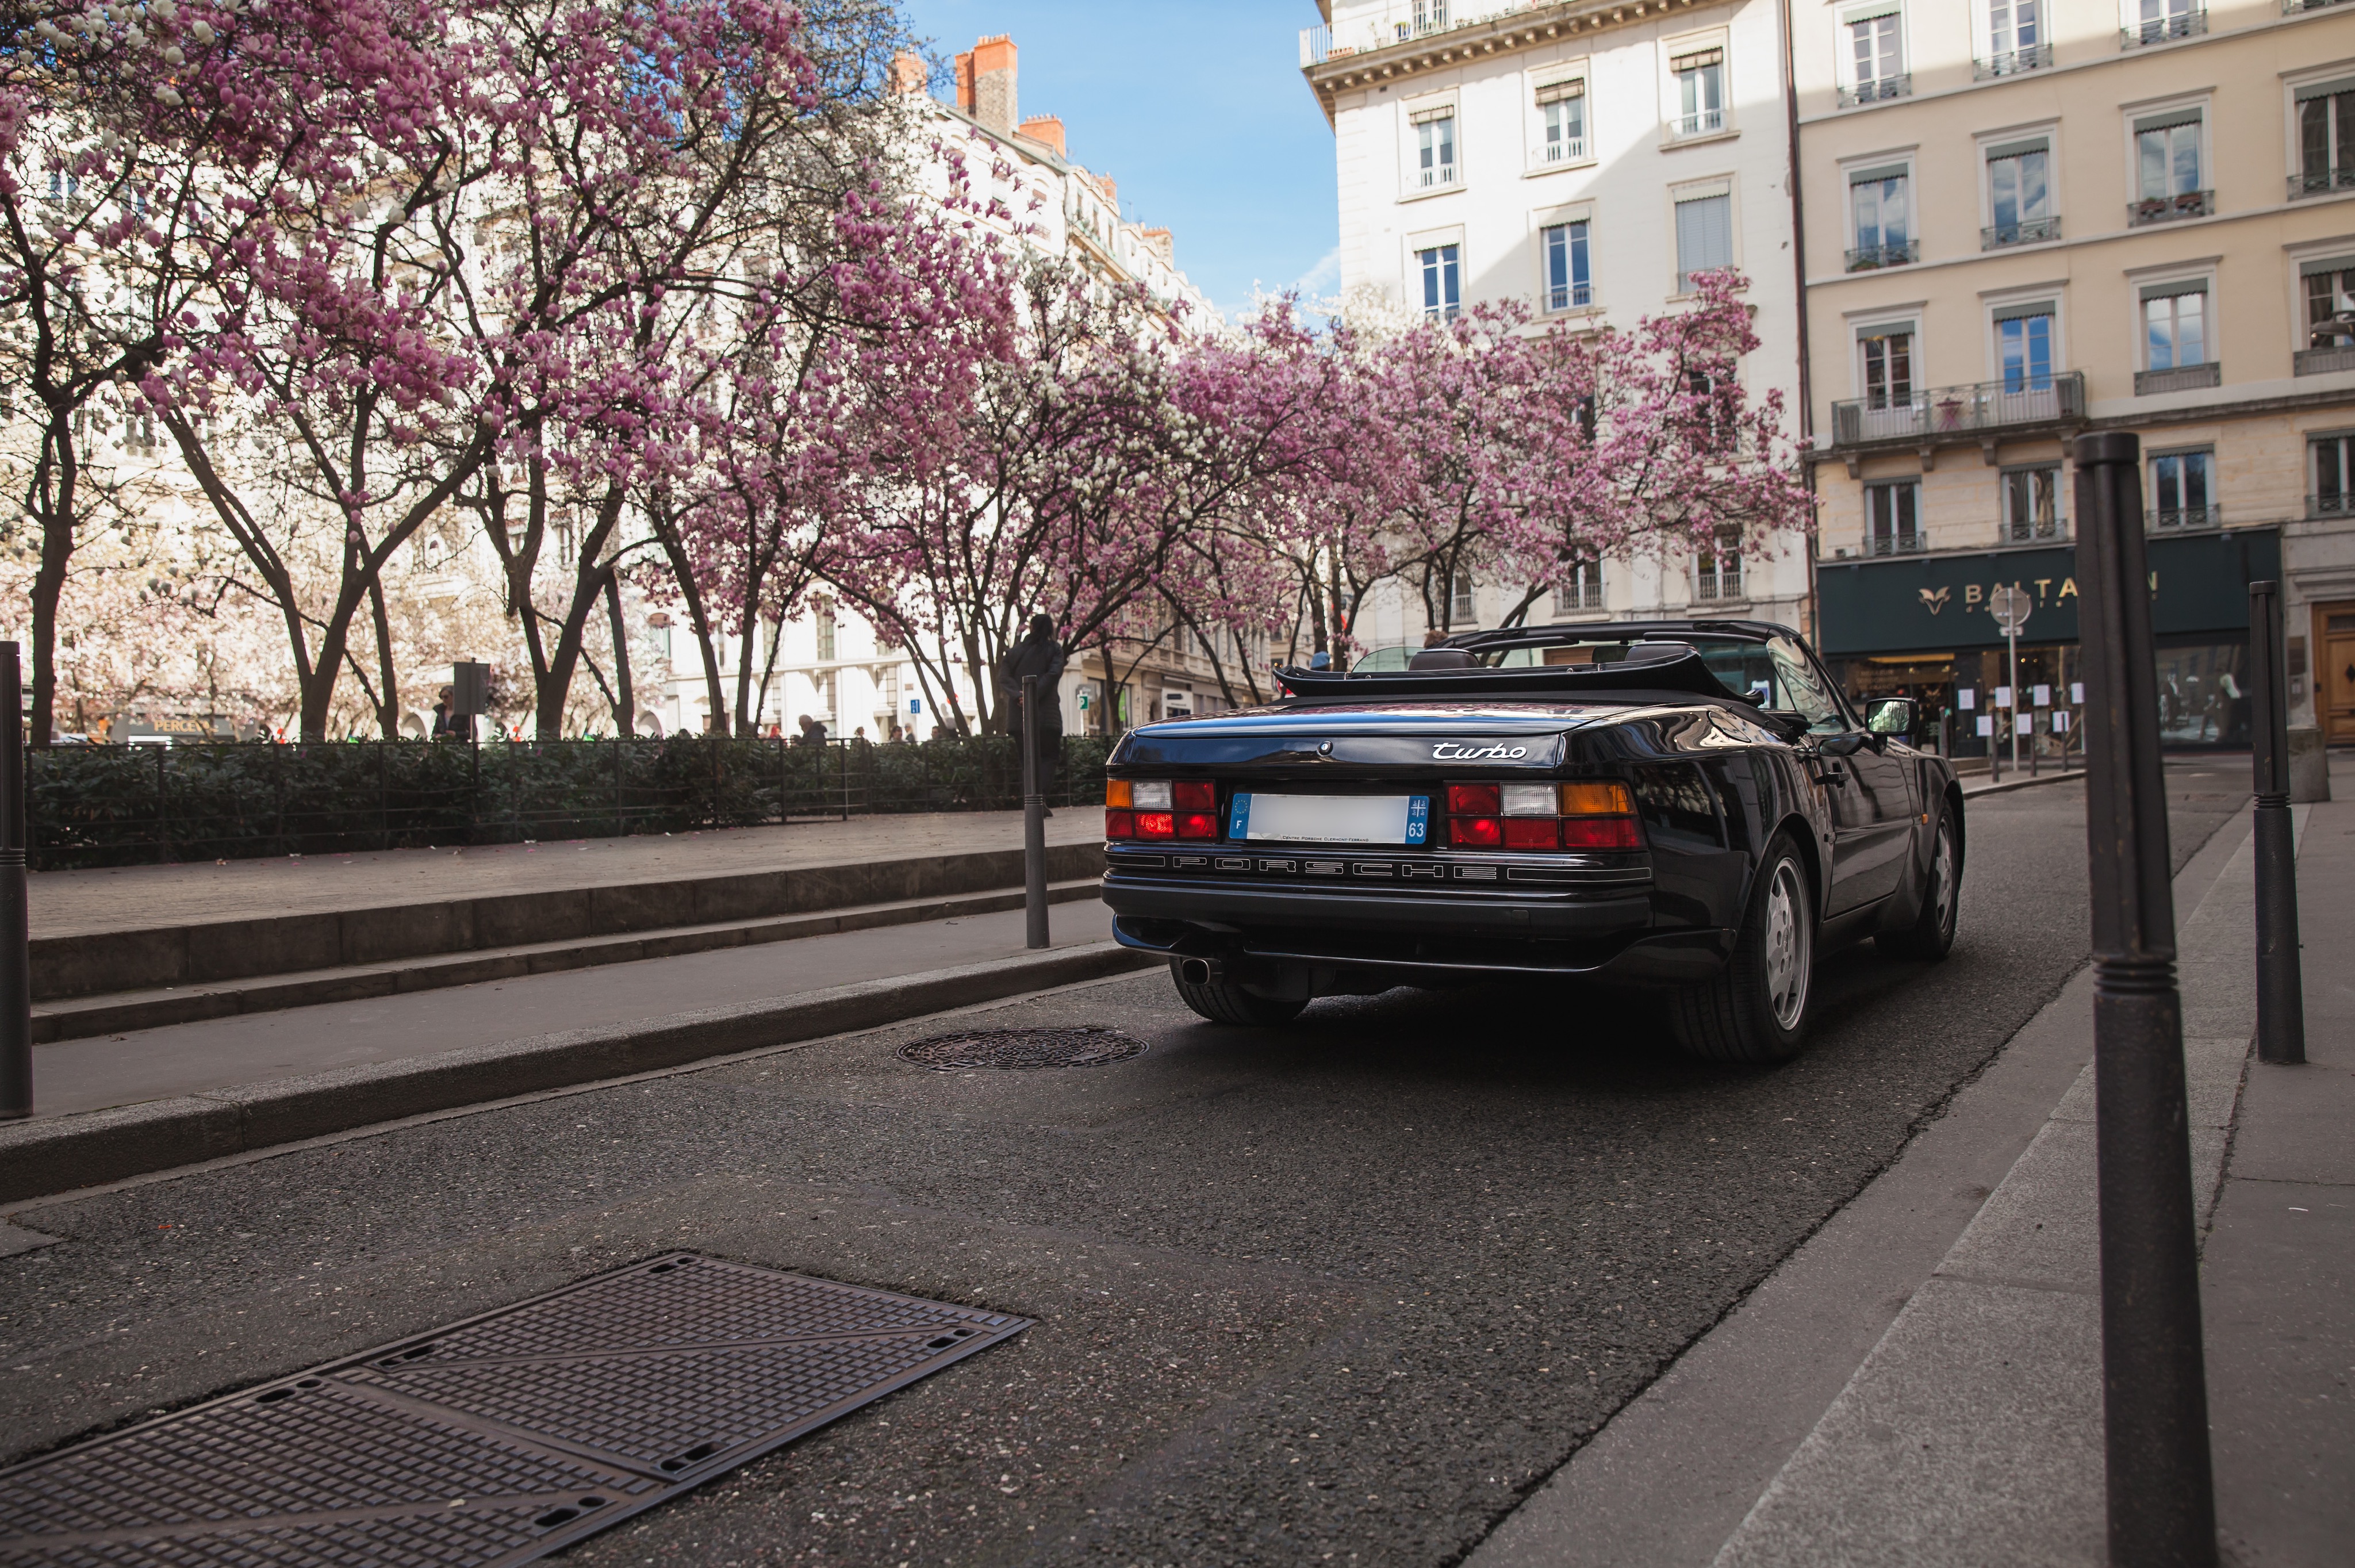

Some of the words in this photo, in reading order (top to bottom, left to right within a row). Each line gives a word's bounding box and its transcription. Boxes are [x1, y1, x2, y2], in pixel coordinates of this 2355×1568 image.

[1965, 571, 2158, 604] BATAN
[154, 719, 219, 733] PERCEV
[1236, 820, 1242, 829] F
[1408, 822, 1424, 837] 63
[1173, 856, 1497, 880] PORSCHE
